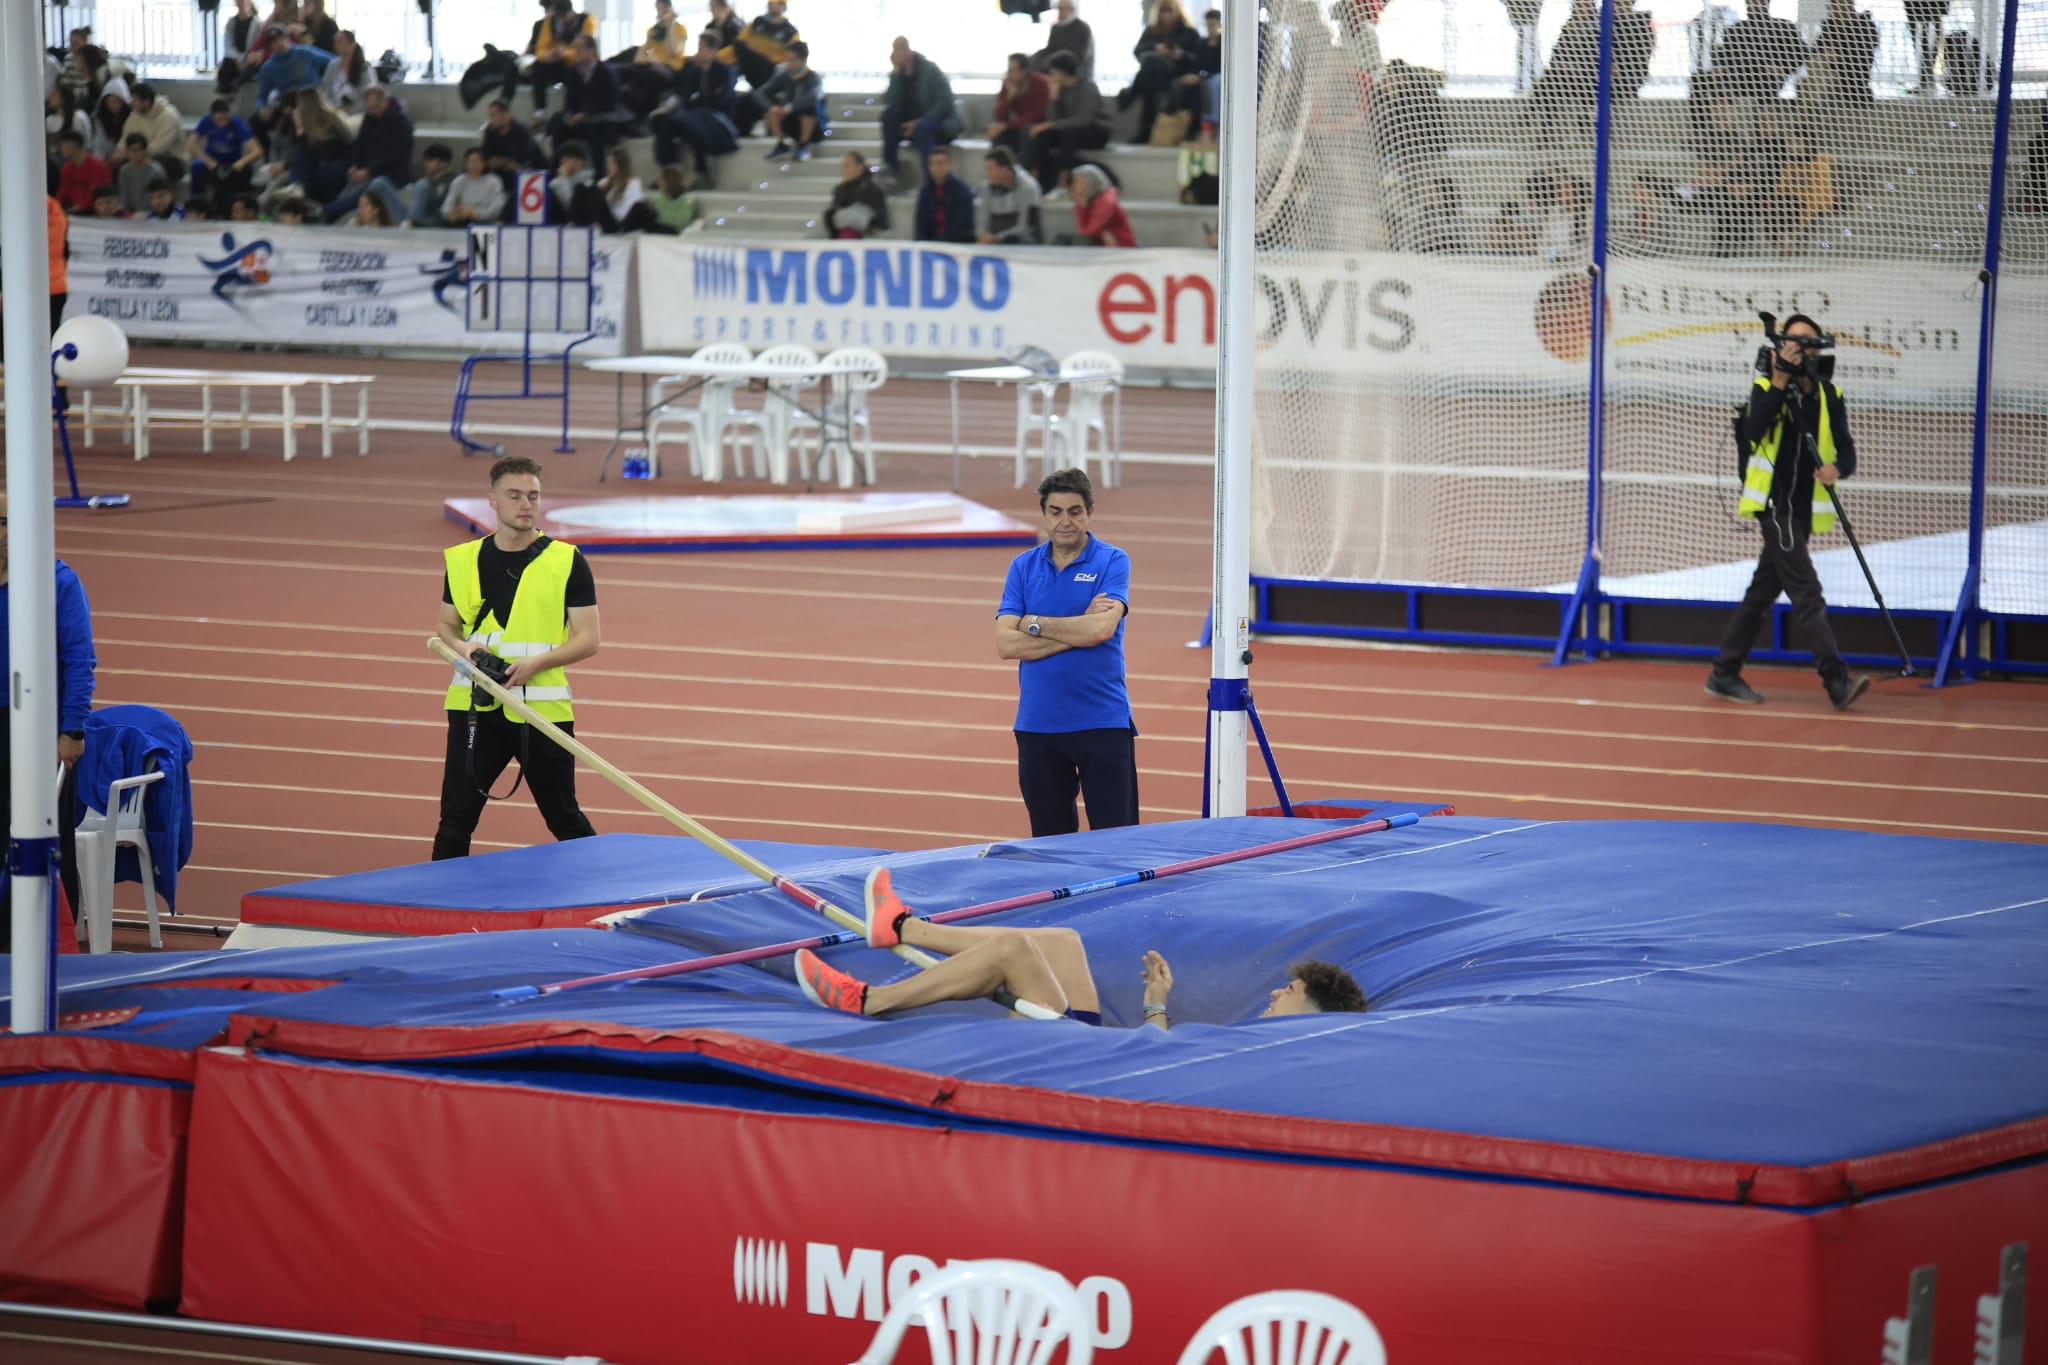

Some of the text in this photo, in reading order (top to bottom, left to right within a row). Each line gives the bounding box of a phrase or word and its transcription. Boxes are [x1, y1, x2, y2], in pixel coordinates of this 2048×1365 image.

[520, 174, 544, 213] 6
[745, 249, 1011, 311] MONDO
[474, 283, 488, 321] 1
[693, 315, 797, 342] SPORT
[812, 319, 827, 342] &
[806, 1241, 1132, 1349] MOO
